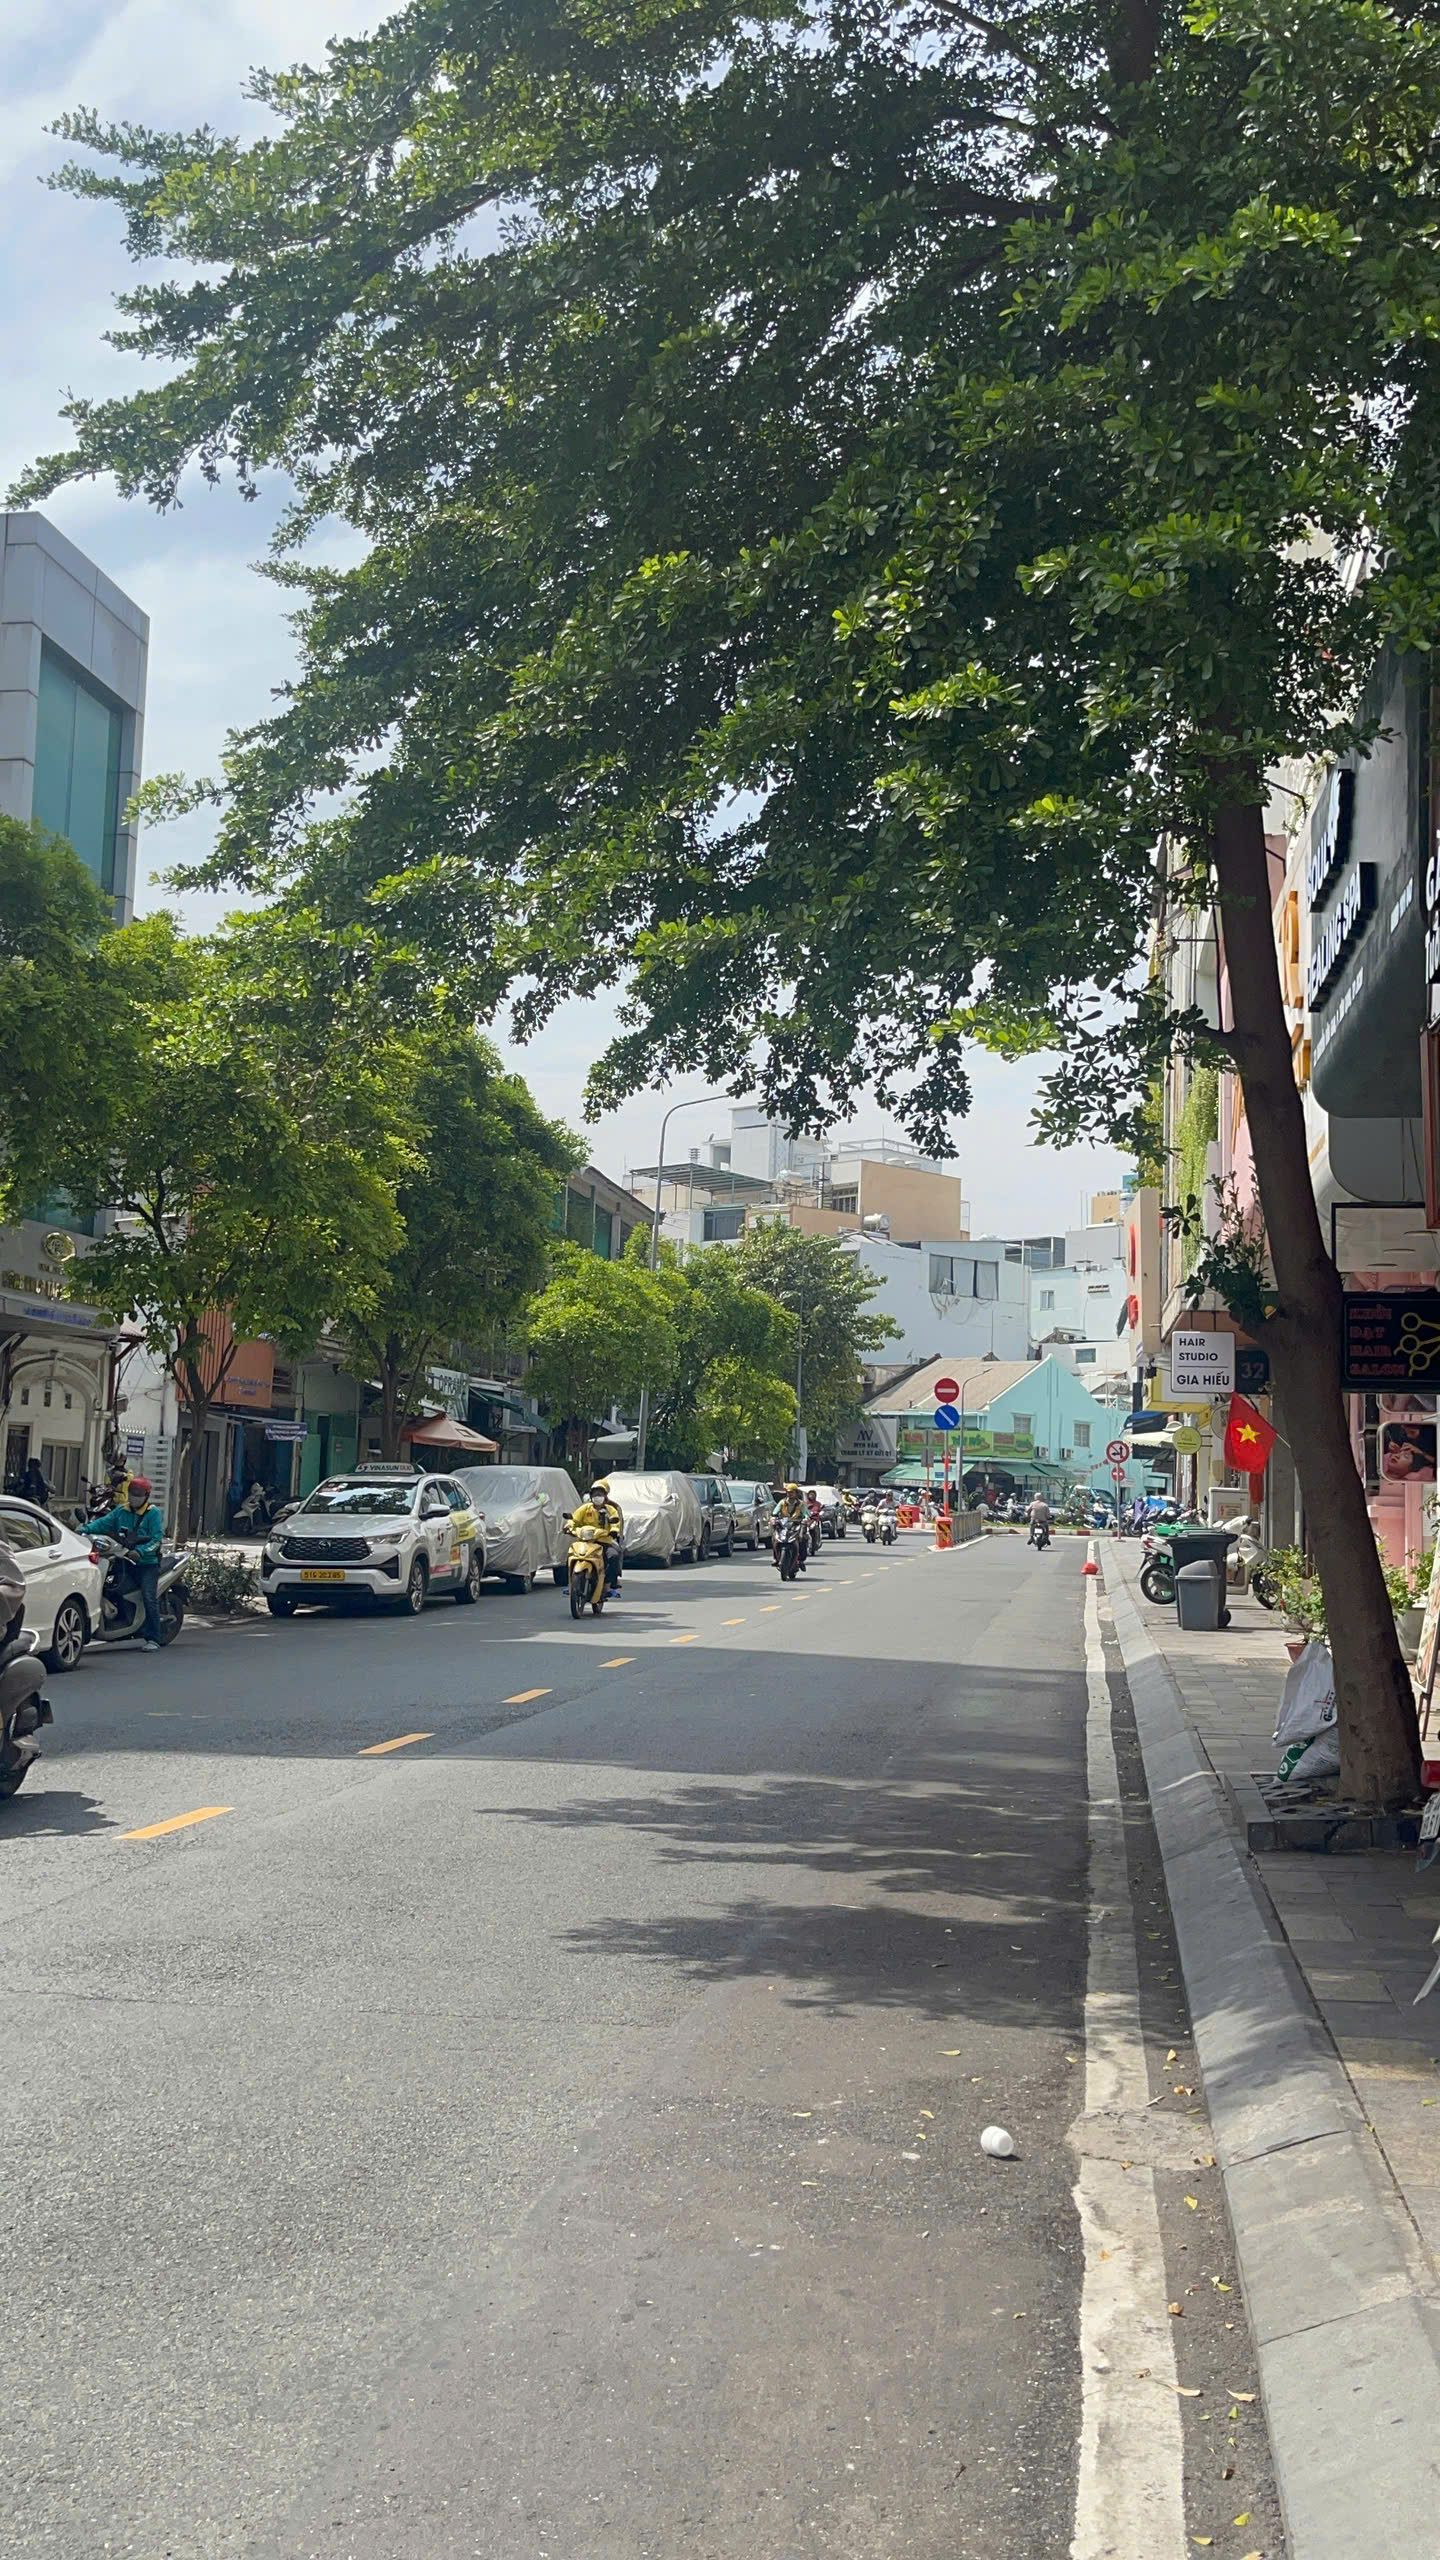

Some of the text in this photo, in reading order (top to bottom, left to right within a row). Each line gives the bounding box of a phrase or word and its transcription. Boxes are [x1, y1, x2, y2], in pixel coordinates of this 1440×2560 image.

[1343, 861, 1362, 941] SPA
[1179, 1338, 1206, 1347] HAIR
[1178, 1352, 1218, 1361] STUDIO
[1241, 1362, 1264, 1379] 32
[1176, 1371, 1230, 1386] GIA HIẾU
